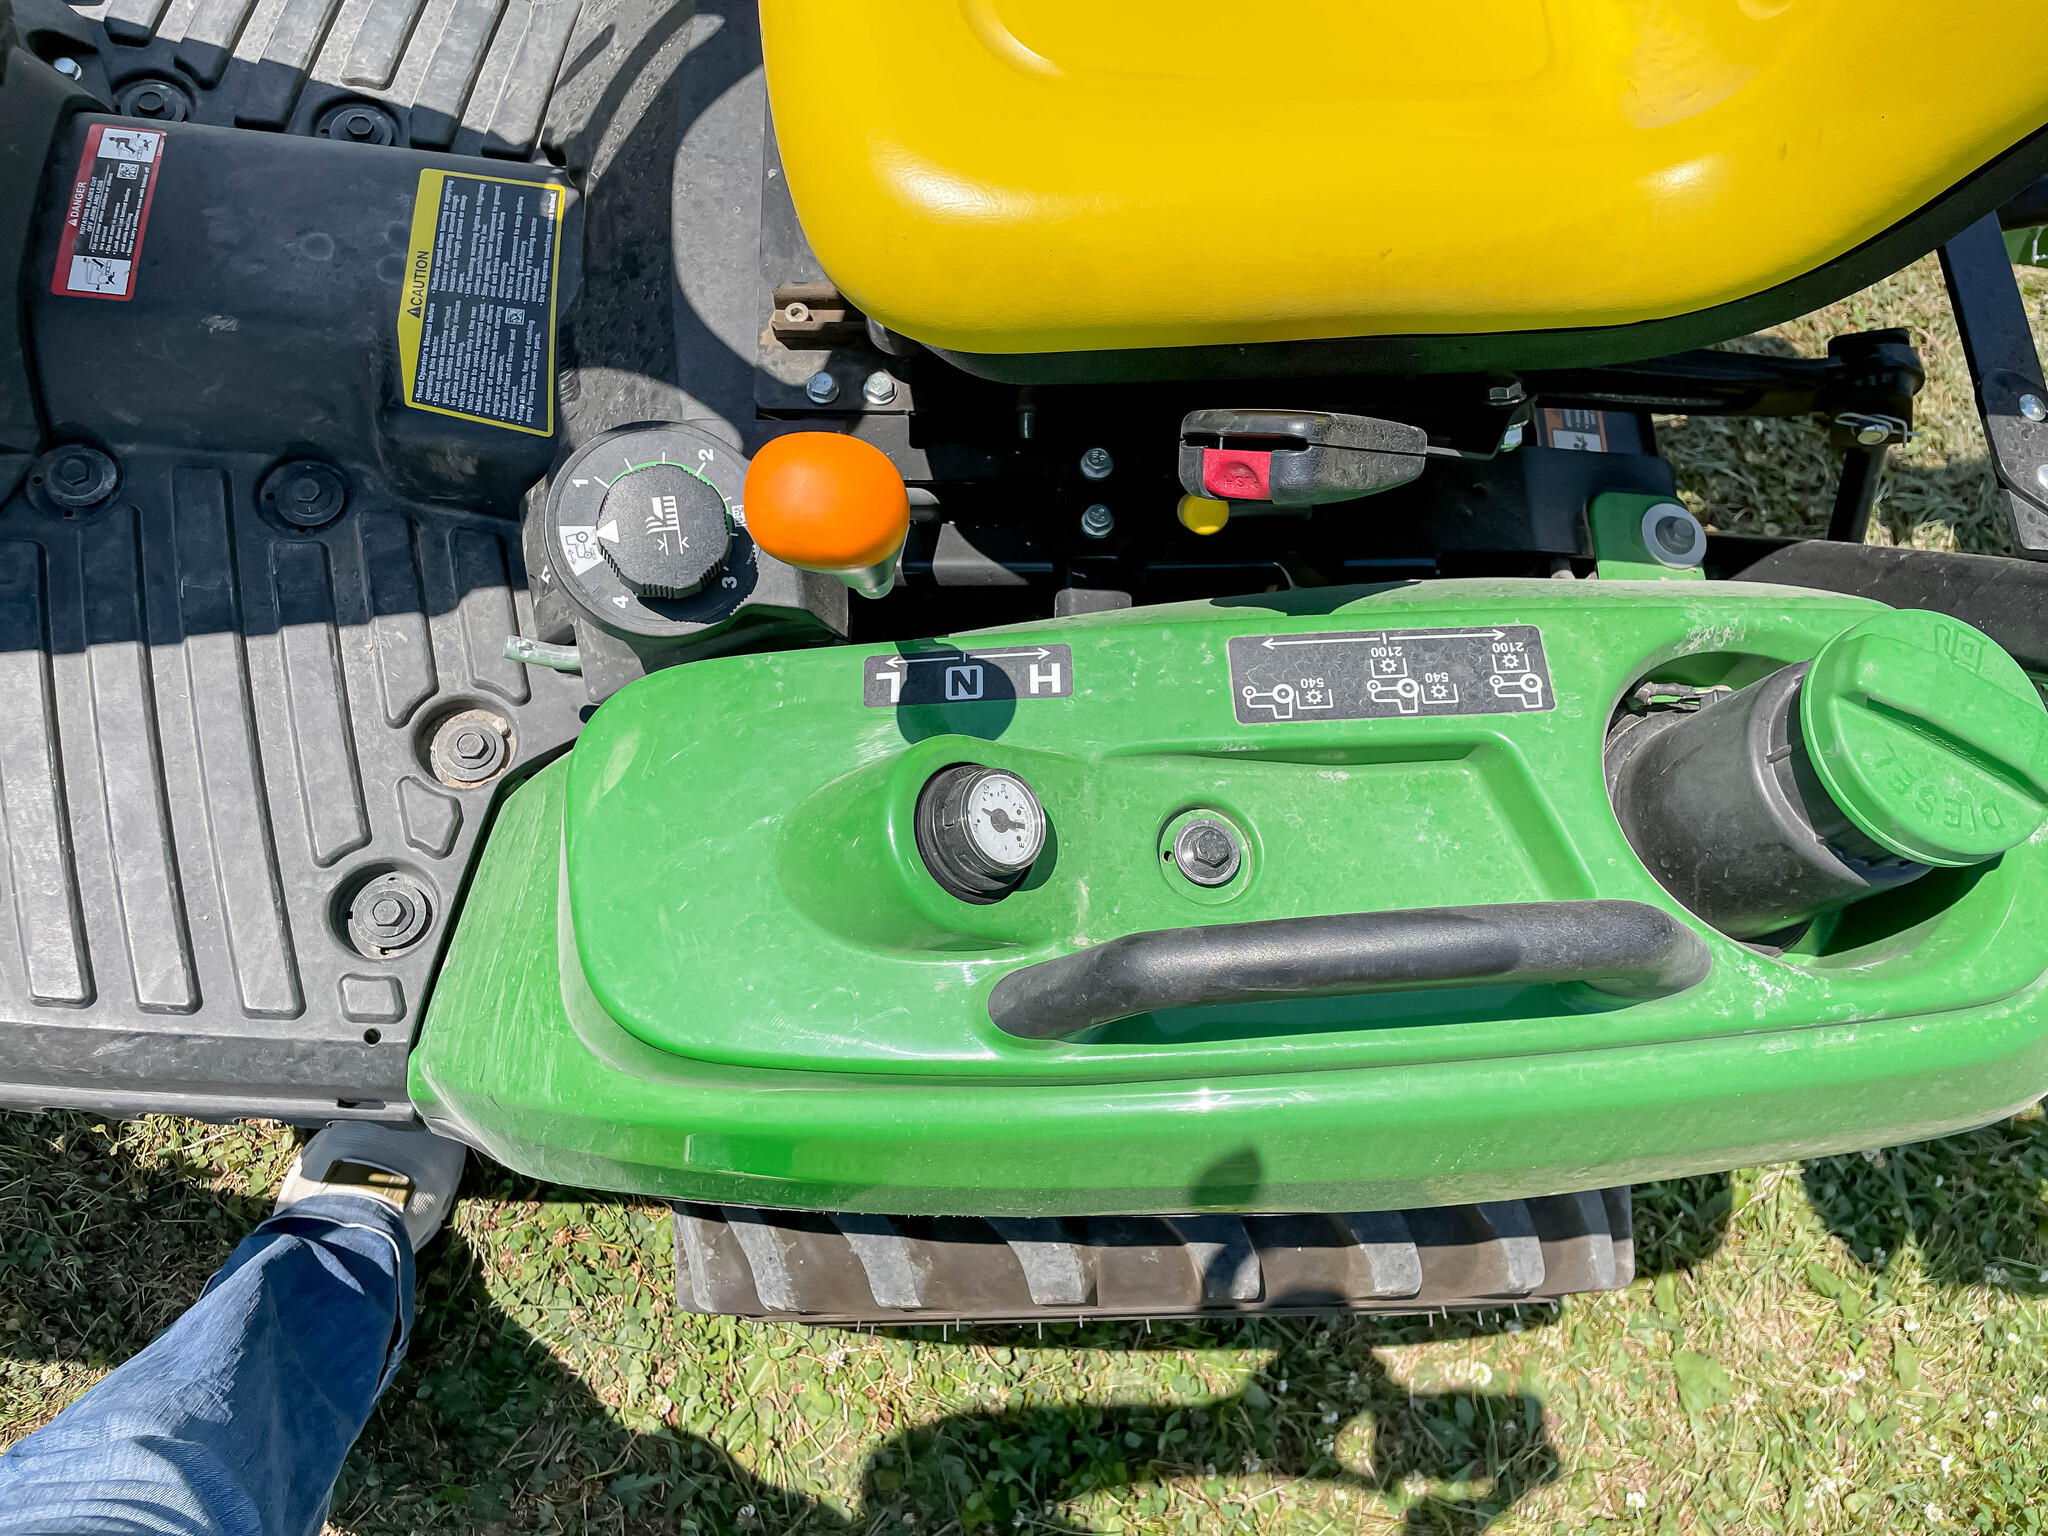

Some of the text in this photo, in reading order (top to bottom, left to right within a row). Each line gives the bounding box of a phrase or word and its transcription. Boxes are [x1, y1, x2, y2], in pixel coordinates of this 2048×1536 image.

[70, 181, 87, 217] DANGER
[409, 250, 430, 306] CAUTION
[478, 302, 487, 321] upset.
[486, 304, 494, 323] others
[494, 306, 503, 329] starting
[439, 330, 448, 355] machine
[450, 324, 459, 343] safety
[474, 322, 483, 349] rearward
[491, 330, 499, 350] before
[525, 320, 535, 344] clothing
[416, 303, 435, 398] Read Operator's Manual before
[455, 341, 465, 367] working.
[466, 338, 474, 352] only
[506, 341, 514, 362] tractor
[424, 370, 436, 400] operating
[431, 334, 439, 356] tractor.
[436, 356, 446, 380] operate
[445, 357, 453, 379] shields
[463, 353, 471, 370] loads
[472, 350, 480, 367] avoid
[480, 345, 489, 370] children
[488, 351, 496, 377] machine
[522, 358, 531, 372] feet,
[530, 371, 538, 390] power
[534, 332, 542, 349] parts.
[496, 354, 506, 385] operation.
[441, 380, 452, 404] guards,
[451, 381, 460, 398] place
[469, 376, 478, 392] plate
[477, 371, 485, 393] certain
[503, 372, 511, 391] riders
[520, 373, 529, 394] hands,
[458, 391, 466, 407] Hitch
[475, 394, 483, 411] Make
[492, 394, 501, 415] engine
[500, 400, 509, 417] Keep
[509, 384, 519, 419] equipment.
[517, 404, 526, 421] Keep
[698, 448, 714, 461] 2
[572, 478, 588, 487] 1
[722, 576, 737, 589] 3
[613, 596, 629, 608] 4
[1371, 647, 1403, 657] 2100
[1492, 642, 1524, 652] 2100
[876, 672, 900, 702] L
[951, 670, 977, 696] N
[1030, 663, 1061, 693] H
[1301, 677, 1324, 688] 540
[1425, 672, 1448, 683] 540
[1875, 741, 2005, 832] DIESEL
